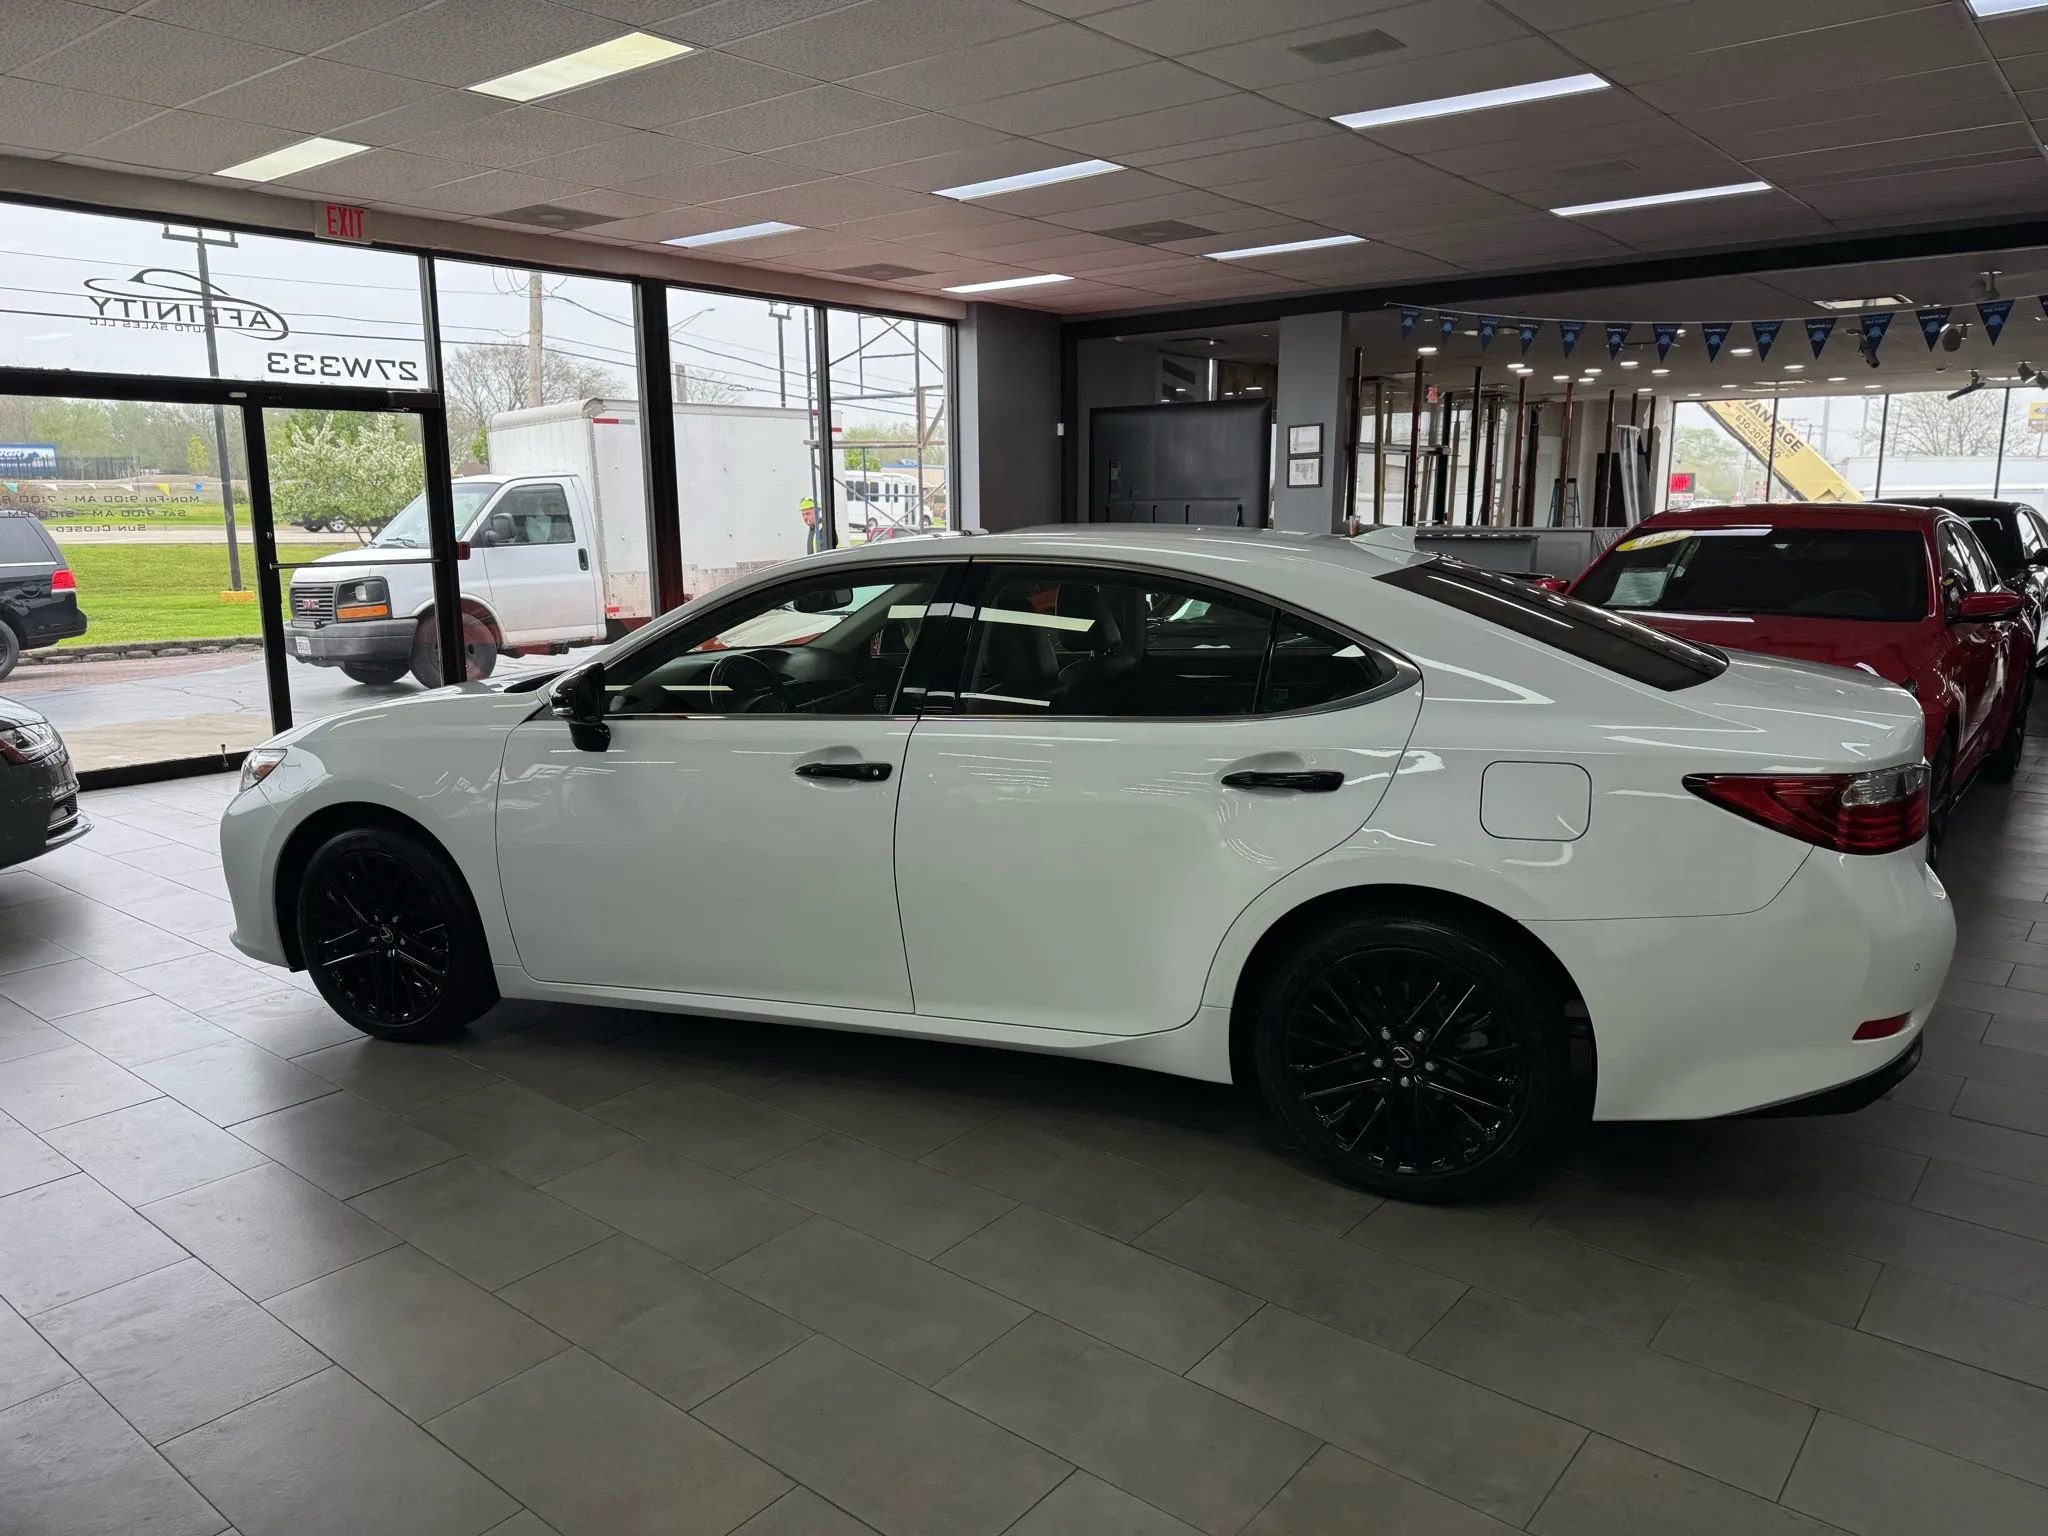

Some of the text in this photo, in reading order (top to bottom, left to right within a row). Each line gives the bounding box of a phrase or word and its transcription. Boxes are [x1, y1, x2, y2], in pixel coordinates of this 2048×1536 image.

[326, 204, 364, 239] EXIT
[1735, 414, 1781, 458] 630.201.60
[1744, 399, 1804, 453] VANAGE
